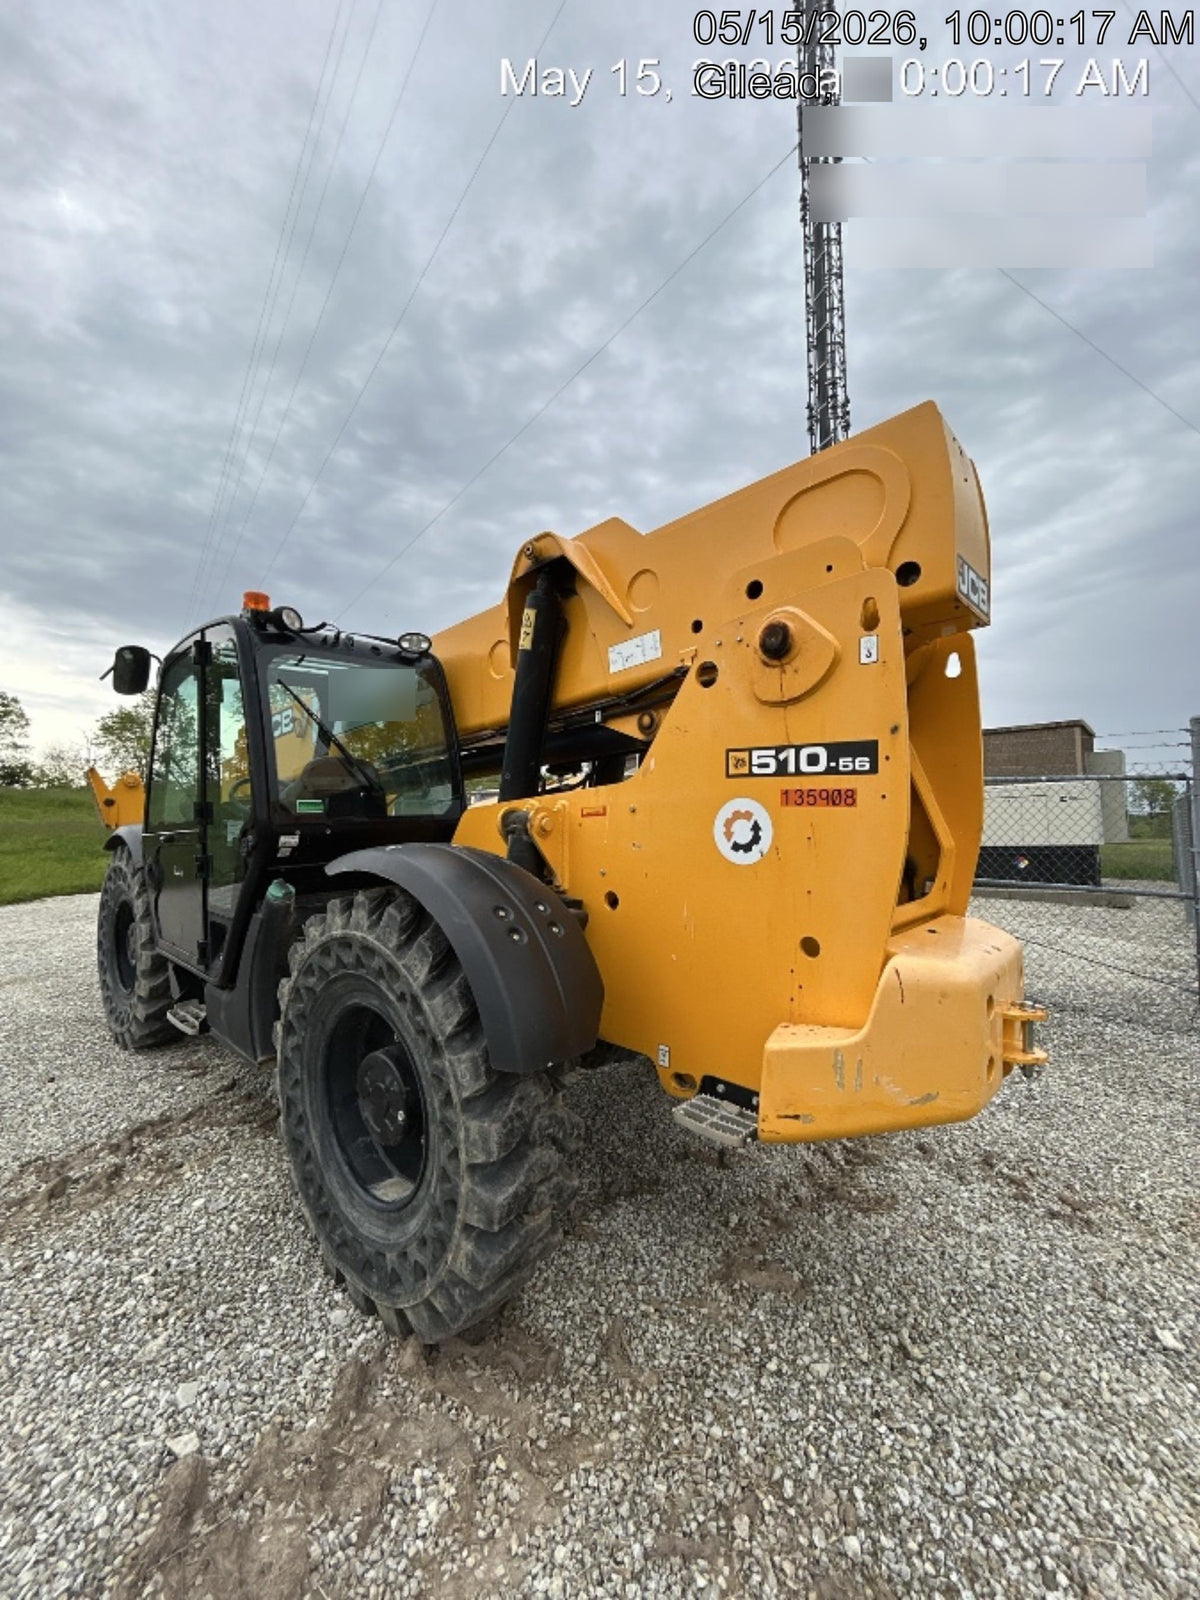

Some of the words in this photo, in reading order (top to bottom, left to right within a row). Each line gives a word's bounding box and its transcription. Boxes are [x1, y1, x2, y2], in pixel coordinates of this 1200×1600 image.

[959, 563, 989, 615] JCB
[751, 746, 871, 775] 510-56
[782, 788, 857, 807] 135908
